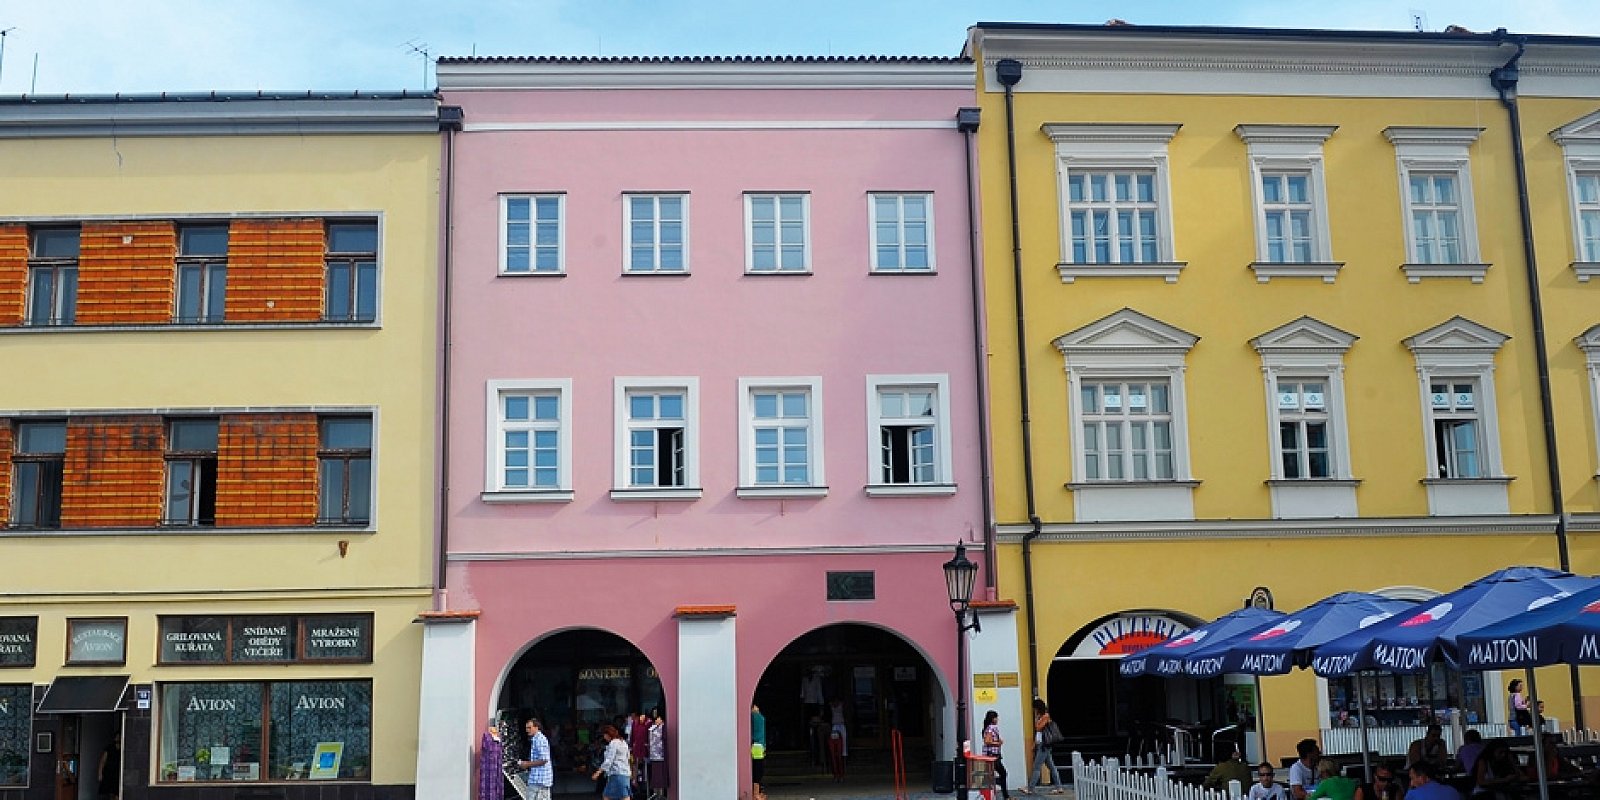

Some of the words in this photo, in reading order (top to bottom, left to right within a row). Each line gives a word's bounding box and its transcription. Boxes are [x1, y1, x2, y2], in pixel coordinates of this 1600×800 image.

[1092, 617, 1186, 650] PIZZERI
[1468, 636, 1538, 665] MATTONI
[1579, 634, 1600, 660] M
[186, 695, 236, 711] AVION
[297, 695, 346, 710] AVION
